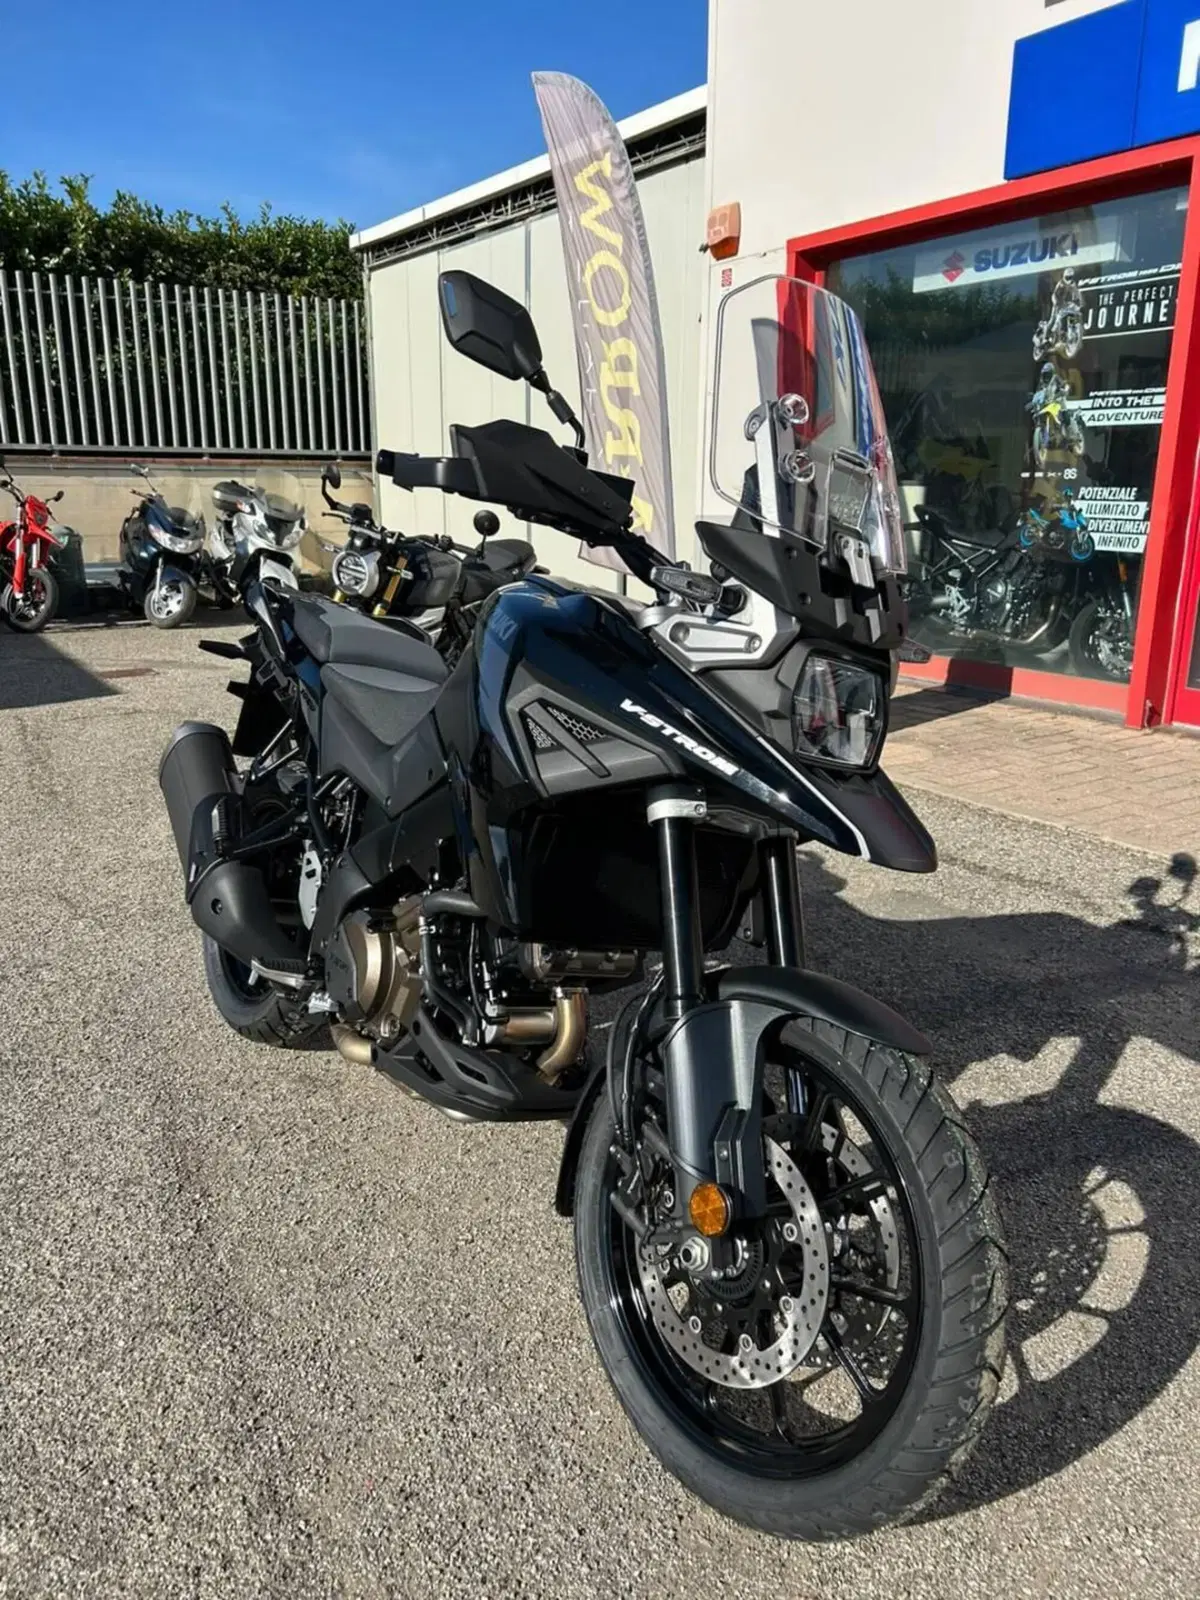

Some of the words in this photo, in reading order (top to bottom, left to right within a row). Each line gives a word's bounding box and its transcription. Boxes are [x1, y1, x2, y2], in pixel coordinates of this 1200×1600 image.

[973, 233, 1078, 273] SUZUKI
[1099, 292, 1114, 306] THE
[1124, 285, 1173, 303] PERFECT
[1083, 299, 1178, 330] JOURNE
[1093, 397, 1122, 408] INTO
[1127, 395, 1153, 407] THE
[1087, 411, 1164, 422] ADVENTURE
[1078, 487, 1138, 500] POTENZIALE
[1085, 504, 1140, 517] ILLIMITATO
[1096, 537, 1140, 549] INFINITO
[619, 698, 739, 776] V-STROM
